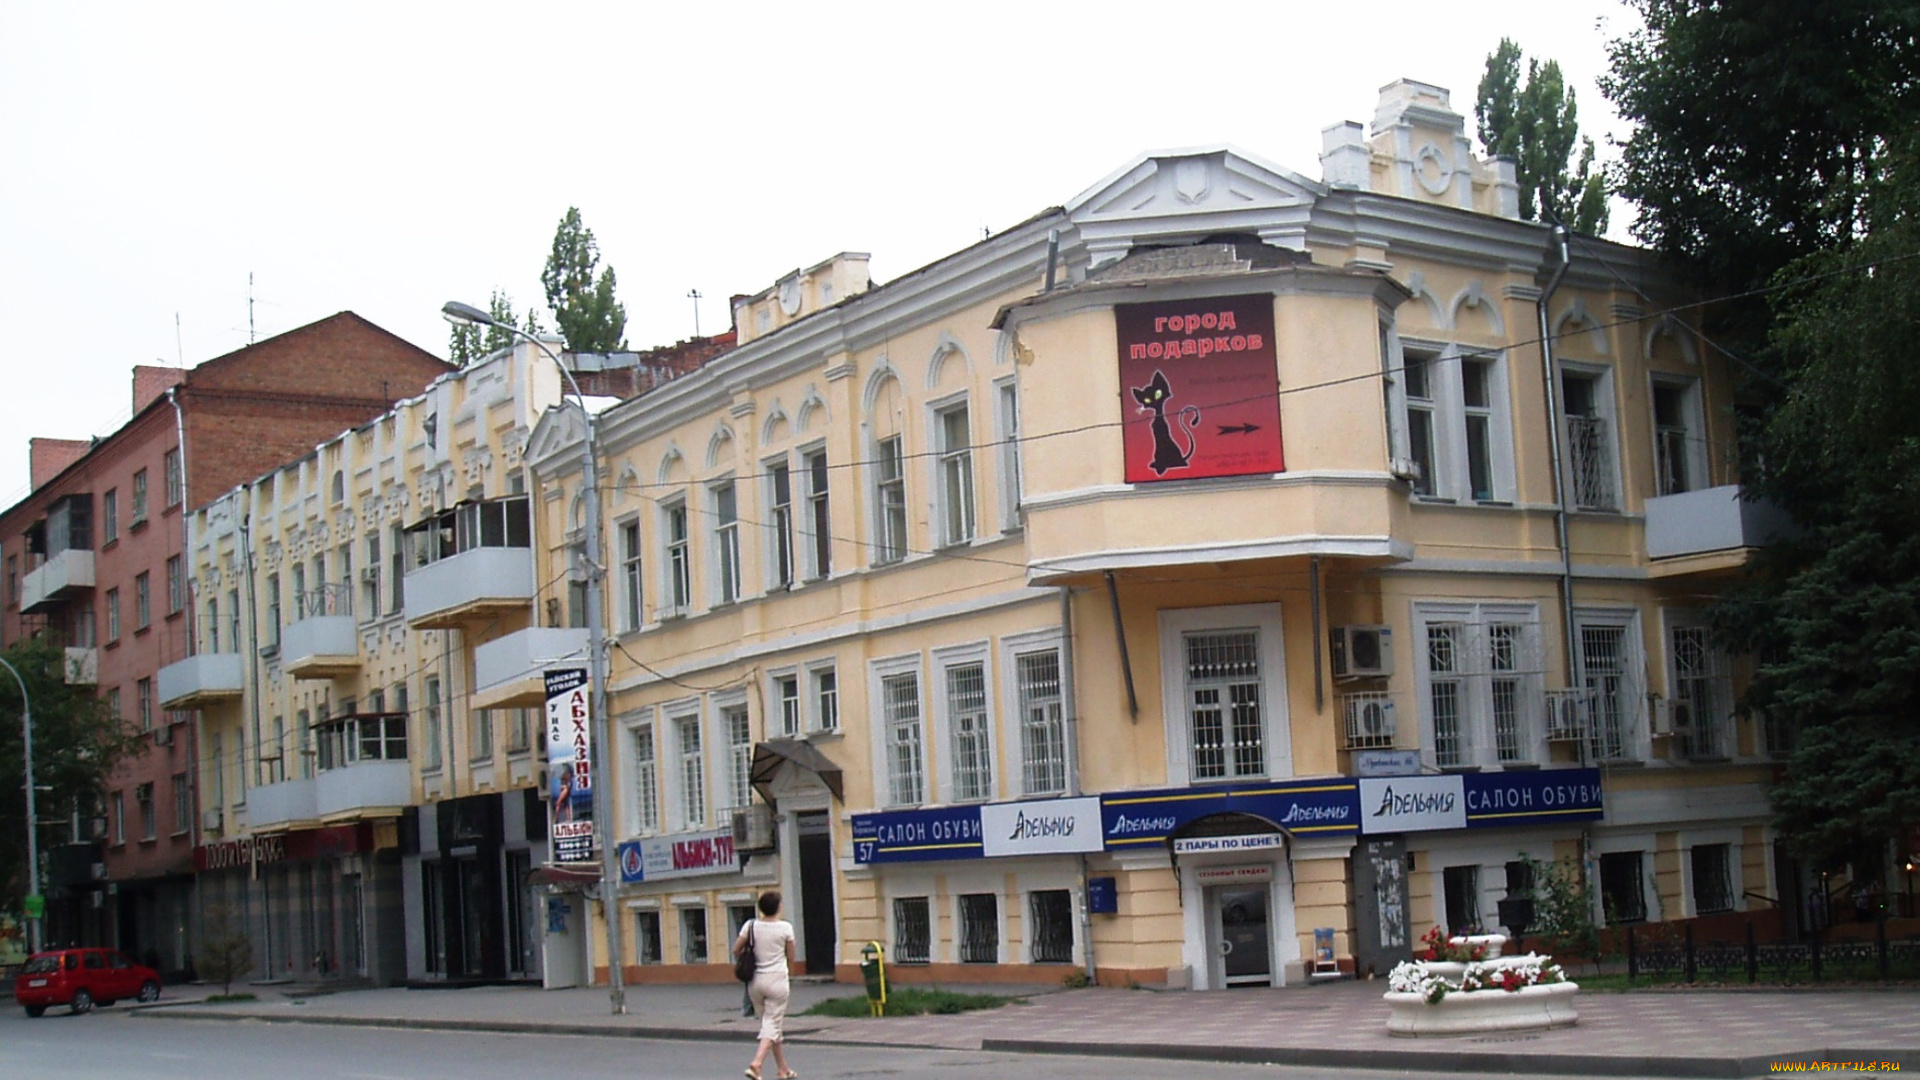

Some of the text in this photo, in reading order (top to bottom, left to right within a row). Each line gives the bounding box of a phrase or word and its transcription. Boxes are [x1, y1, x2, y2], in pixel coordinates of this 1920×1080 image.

[1155, 311, 1236, 334] город
[1130, 334, 1263, 359] подарков
[570, 690, 590, 790] АБХАЗИЯ
[1467, 784, 1601, 810] САЛОН ОБУВИ
[878, 819, 981, 843] САЛОН ОБУВИ
[860, 843, 873, 861] 57
[1176, 842, 1183, 851] 2
[1186, 840, 1218, 851] ПАРЫ
[1222, 839, 1238, 849] ПО
[1242, 837, 1272, 848] ЦЕНЕ
